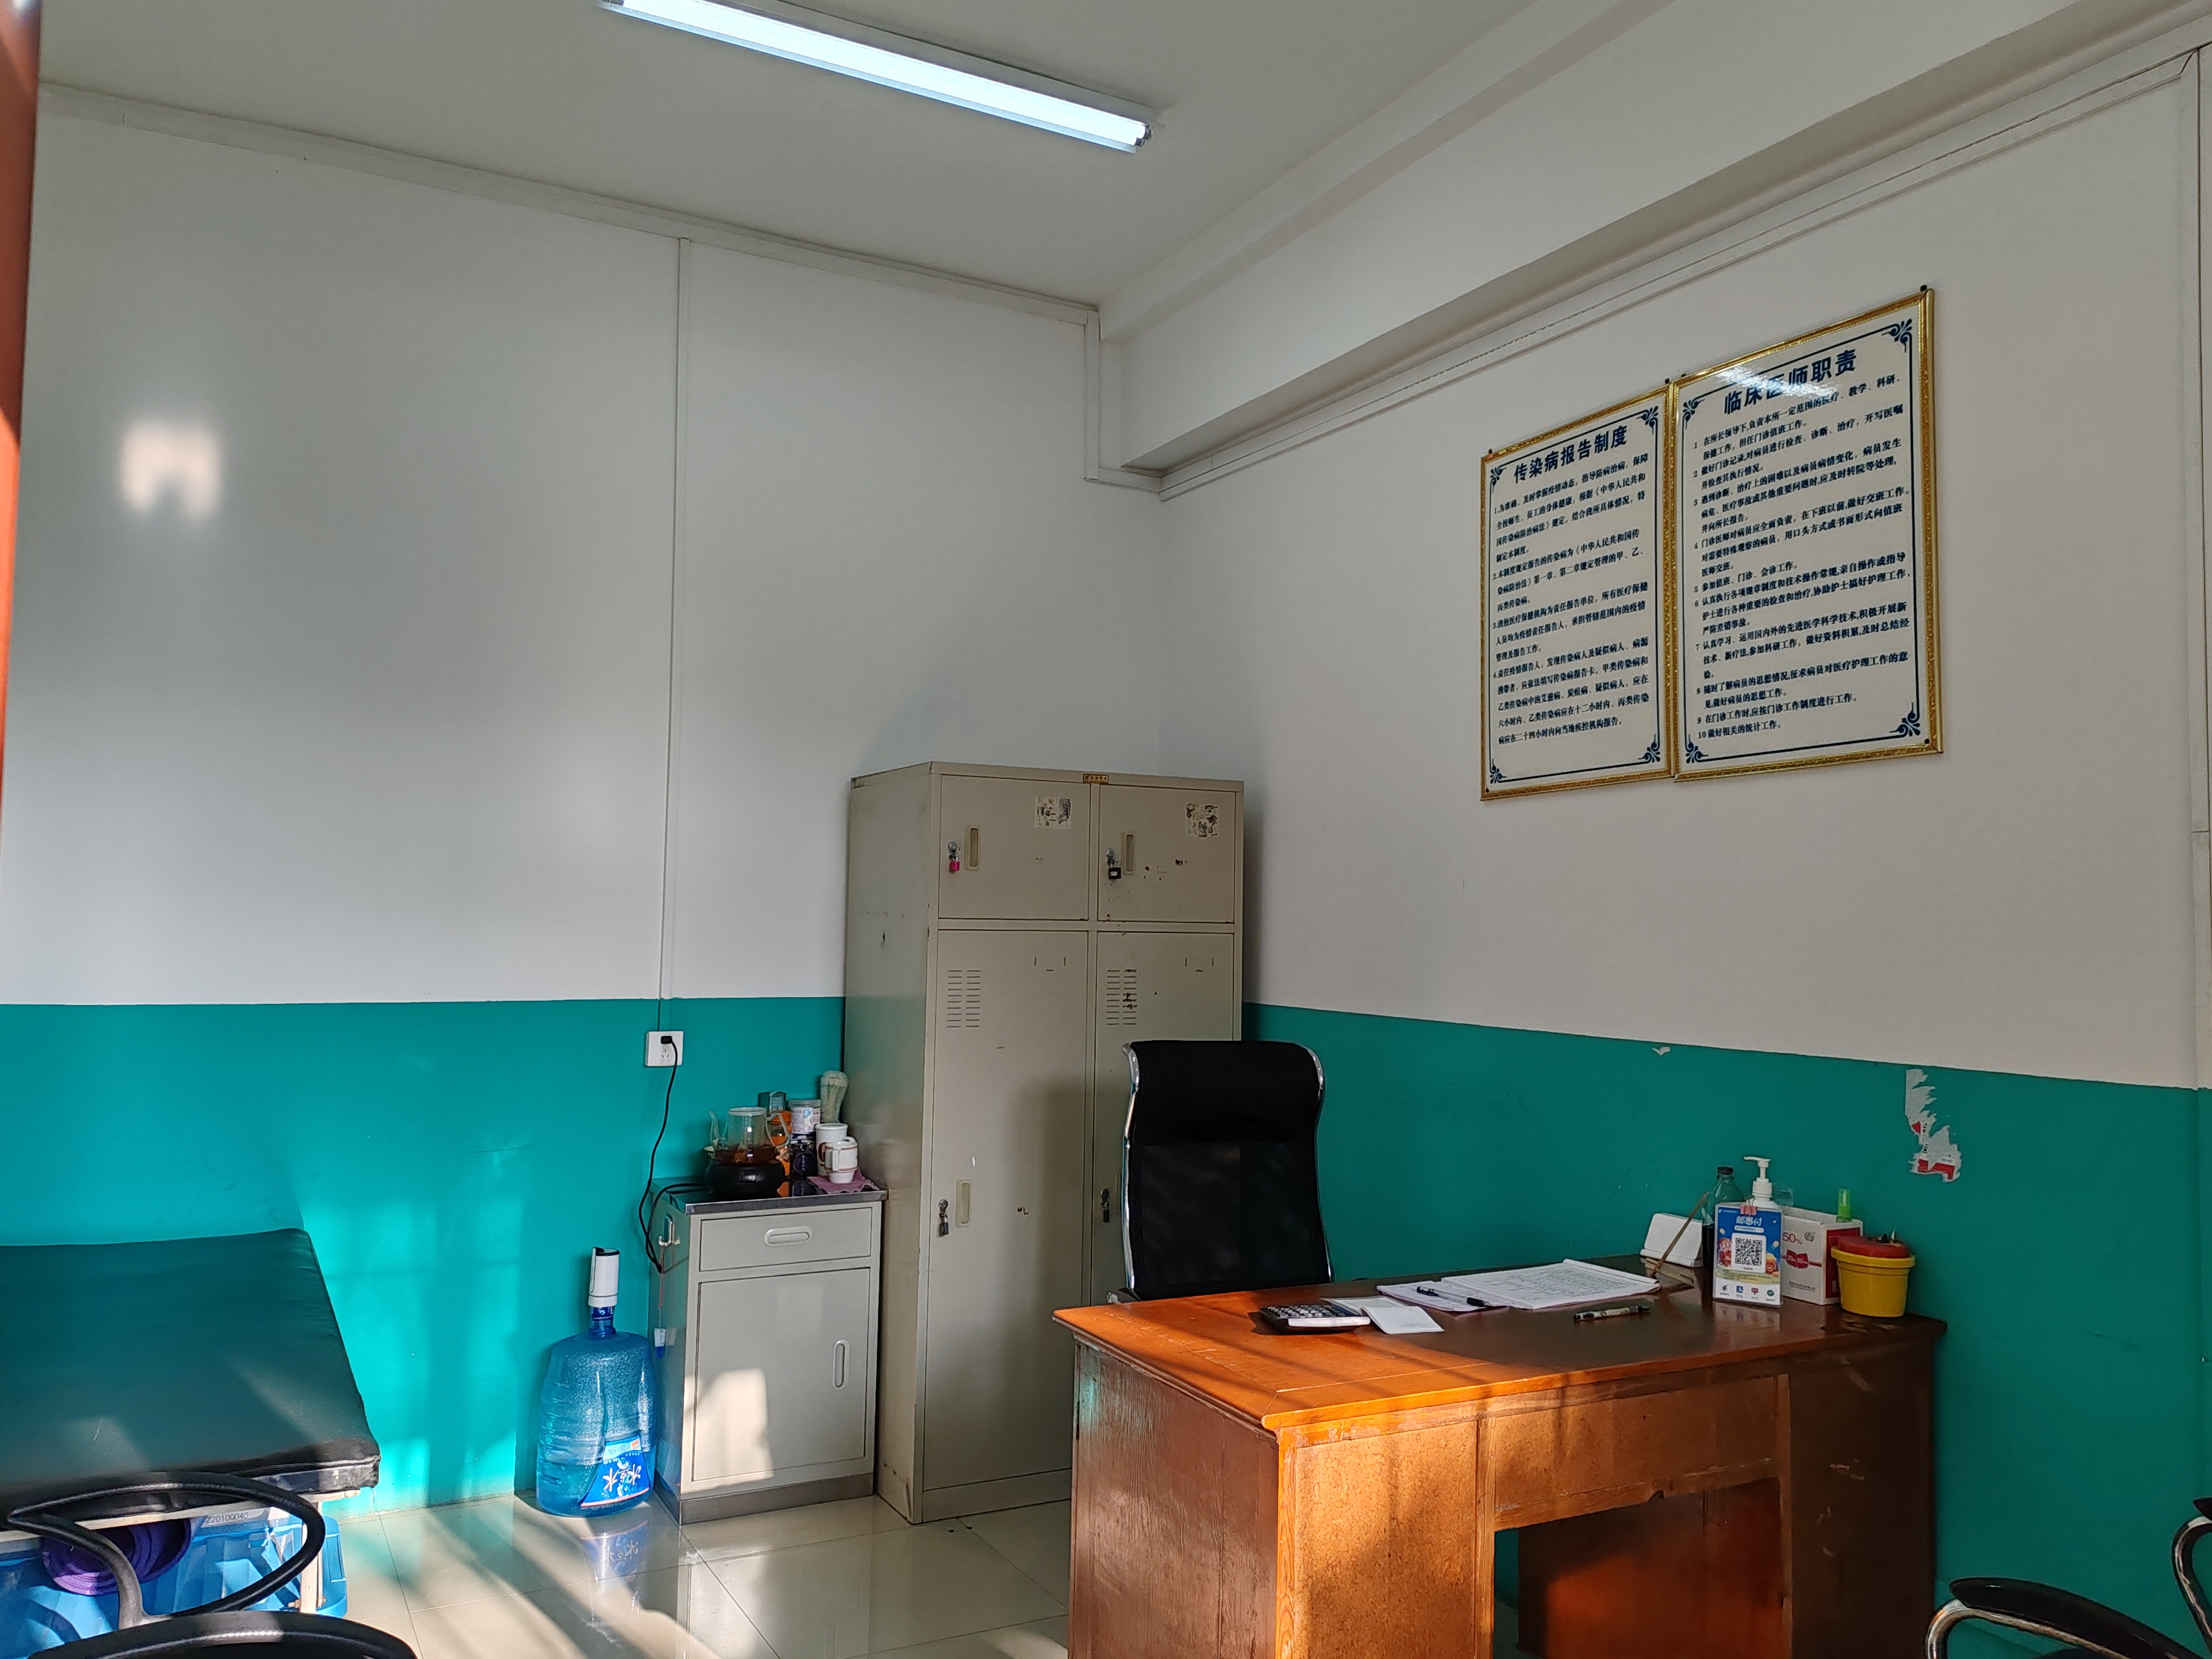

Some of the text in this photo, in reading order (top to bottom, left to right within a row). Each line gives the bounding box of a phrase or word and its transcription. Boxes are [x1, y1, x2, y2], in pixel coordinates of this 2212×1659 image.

[1724, 349, 1857, 415] 临床医师职责
[1514, 425, 1627, 484] 传染病报告制度
[1736, 1215, 1762, 1227] 邮惠付
[206, 1512, 249, 1523] Z20100040
